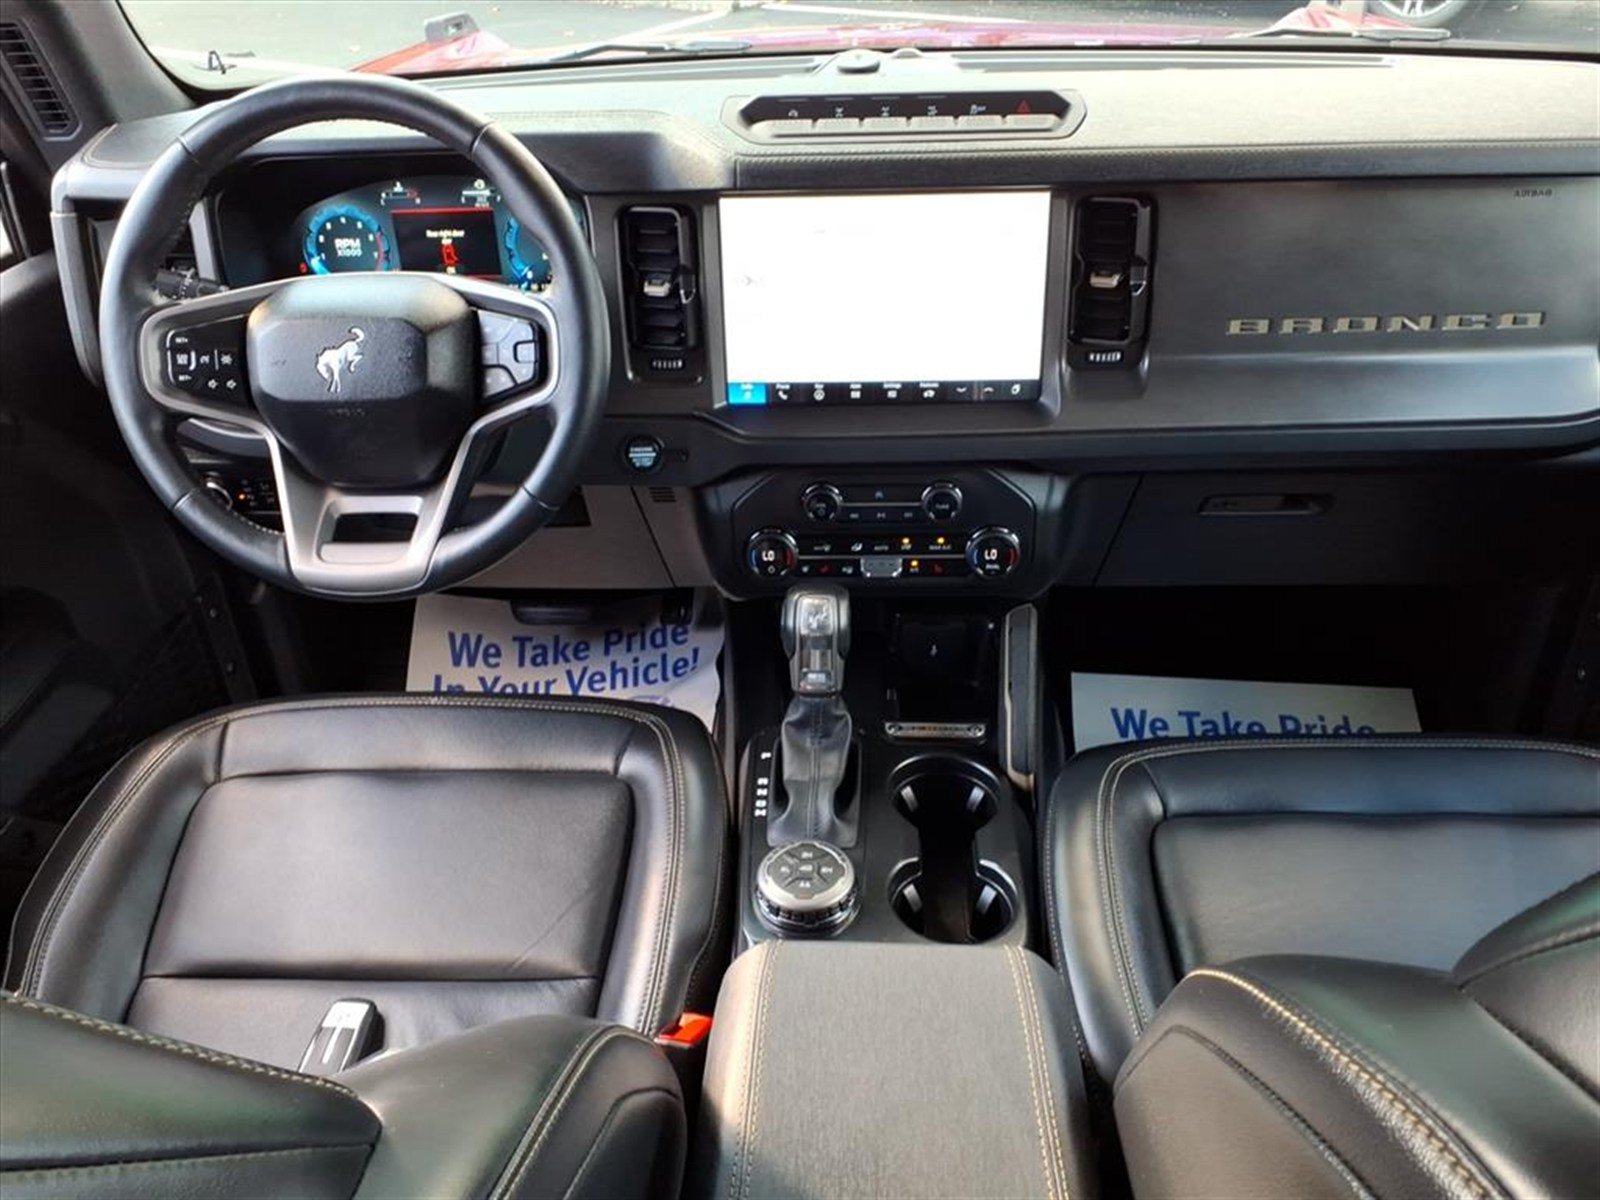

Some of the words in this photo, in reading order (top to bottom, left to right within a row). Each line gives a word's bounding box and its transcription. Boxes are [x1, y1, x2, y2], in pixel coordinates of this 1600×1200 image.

[334, 238, 361, 249] RPM
[1226, 312, 1547, 336] BRONCO
[762, 550, 775, 561] LO
[985, 549, 998, 560] LO
[448, 631, 502, 668] We
[512, 635, 591, 668] Take
[603, 623, 689, 656] Pride
[565, 648, 700, 696] Vehicle!
[1110, 707, 1169, 740] We
[1178, 711, 1266, 738] Take
[1278, 714, 1376, 737] Pride
